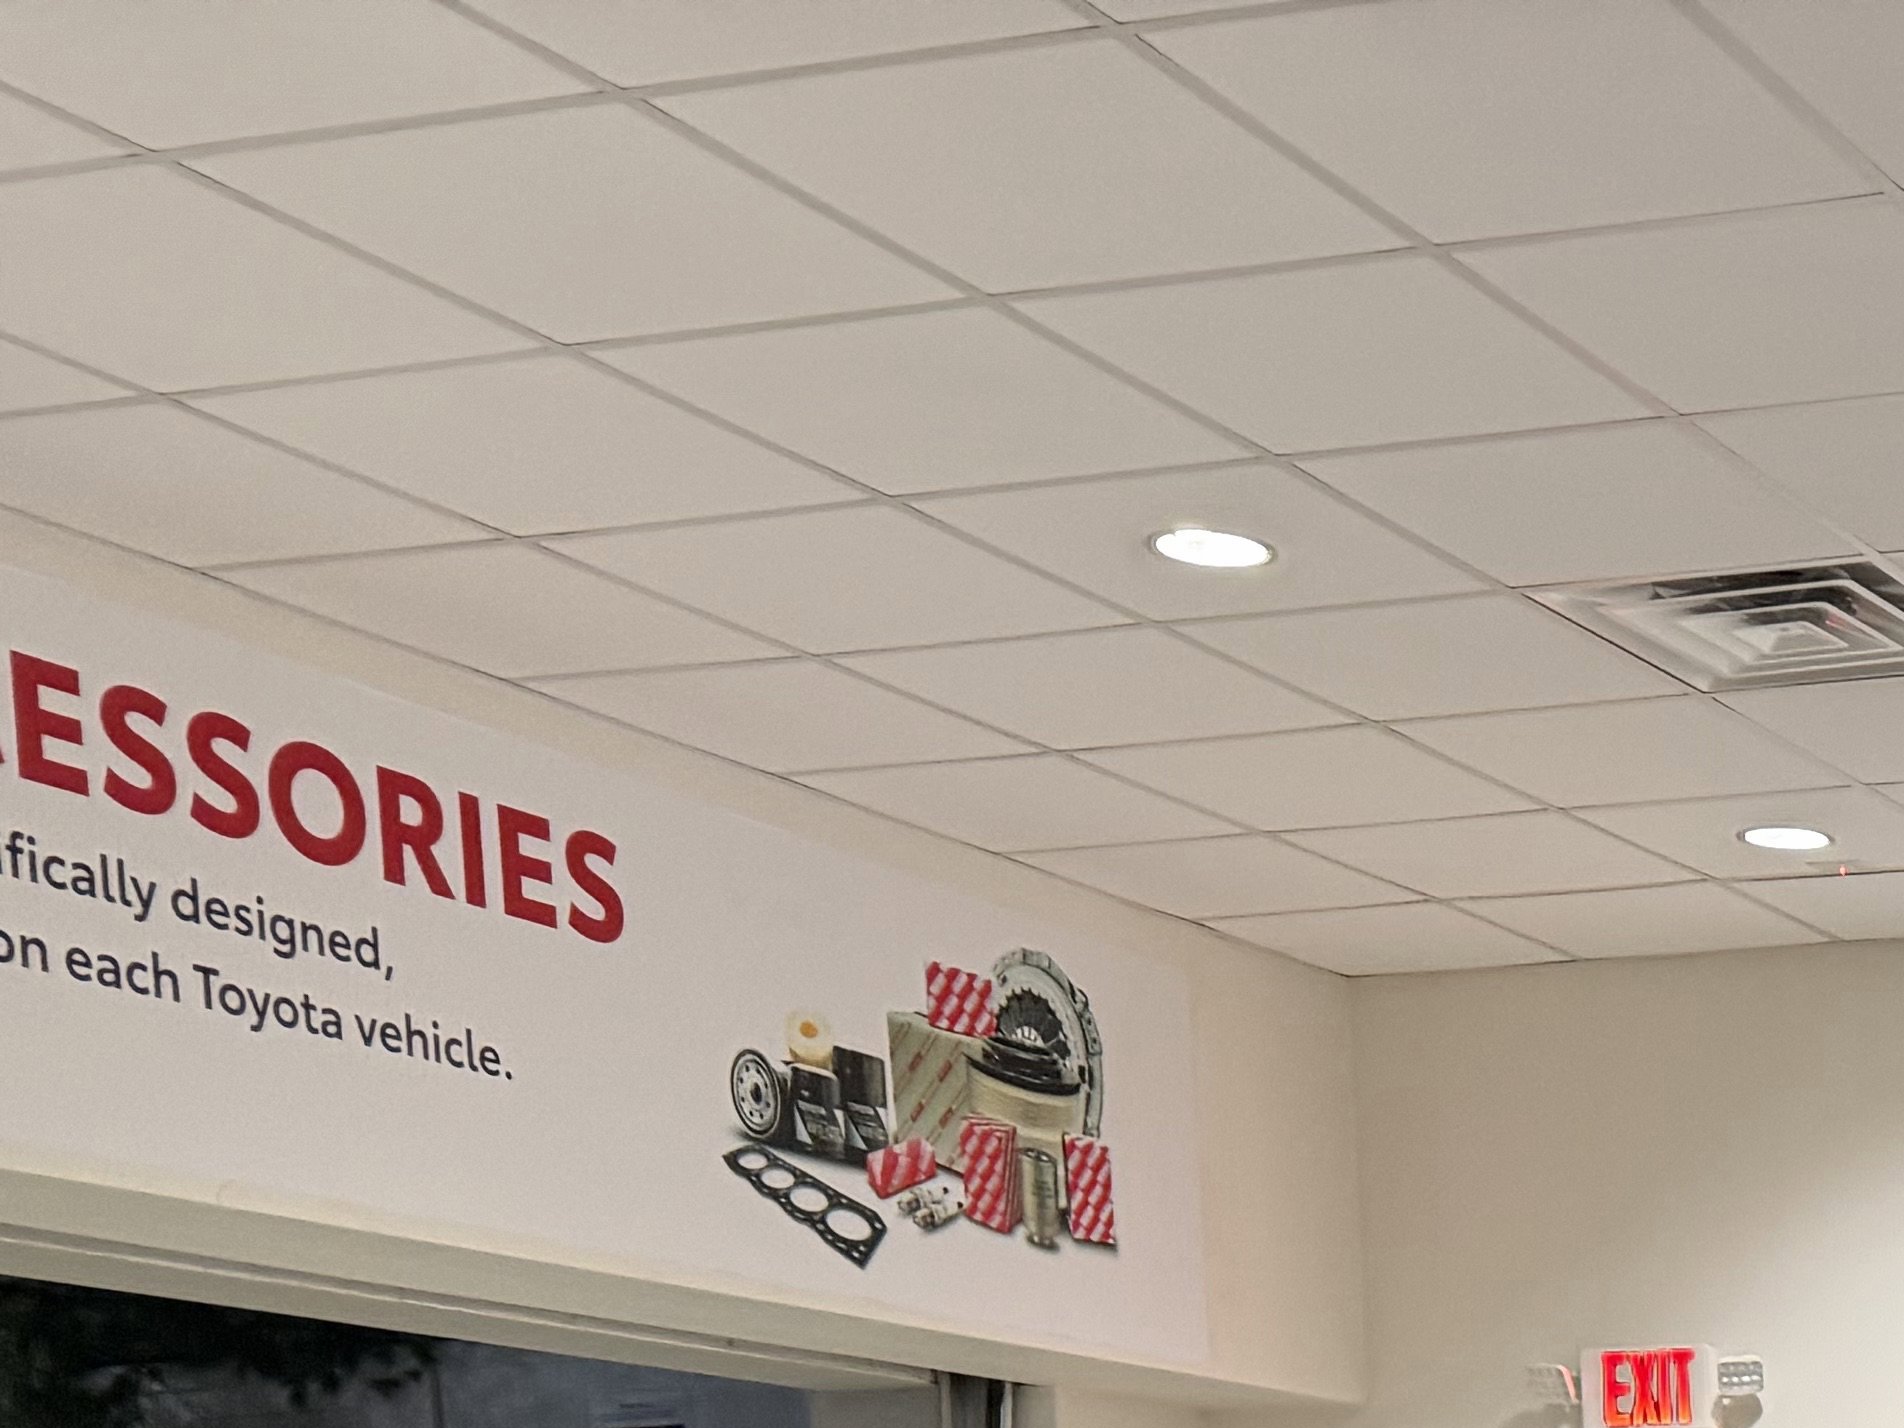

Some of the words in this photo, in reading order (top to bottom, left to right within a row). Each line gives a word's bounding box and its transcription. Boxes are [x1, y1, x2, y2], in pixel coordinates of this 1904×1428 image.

[0, 650, 624, 943] ESSORIES
[0, 831, 156, 922] fically
[171, 878, 394, 981] designed,
[66, 947, 180, 1002] each
[193, 964, 343, 1041] Toyota
[354, 1013, 514, 1080] vehicle.
[1600, 1347, 1697, 1428] EXIT
